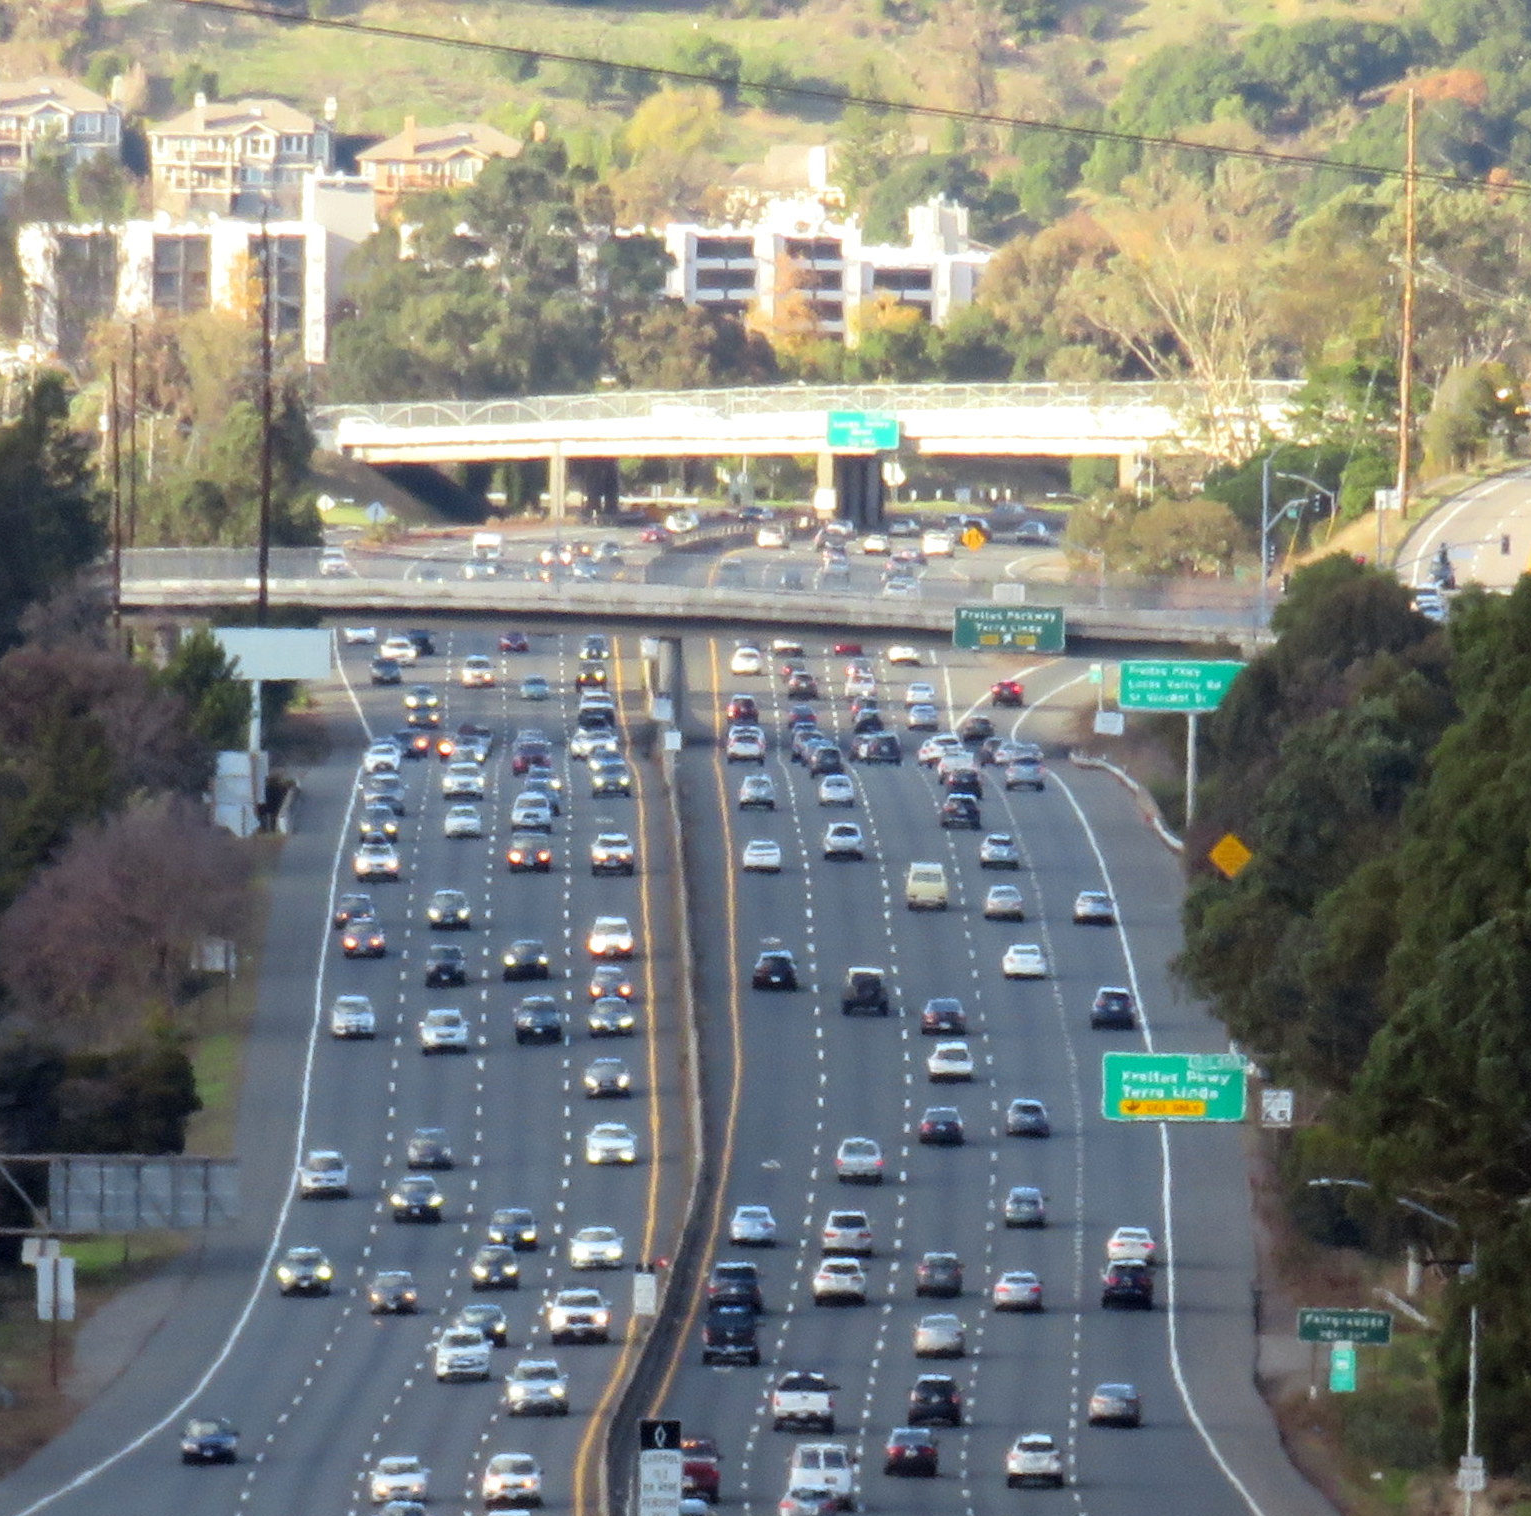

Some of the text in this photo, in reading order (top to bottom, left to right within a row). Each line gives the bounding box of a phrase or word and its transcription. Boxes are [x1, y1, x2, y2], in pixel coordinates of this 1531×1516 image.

[1122, 1070, 1178, 1083] Freitas
[1122, 1085, 1219, 1100] Terra Linda
